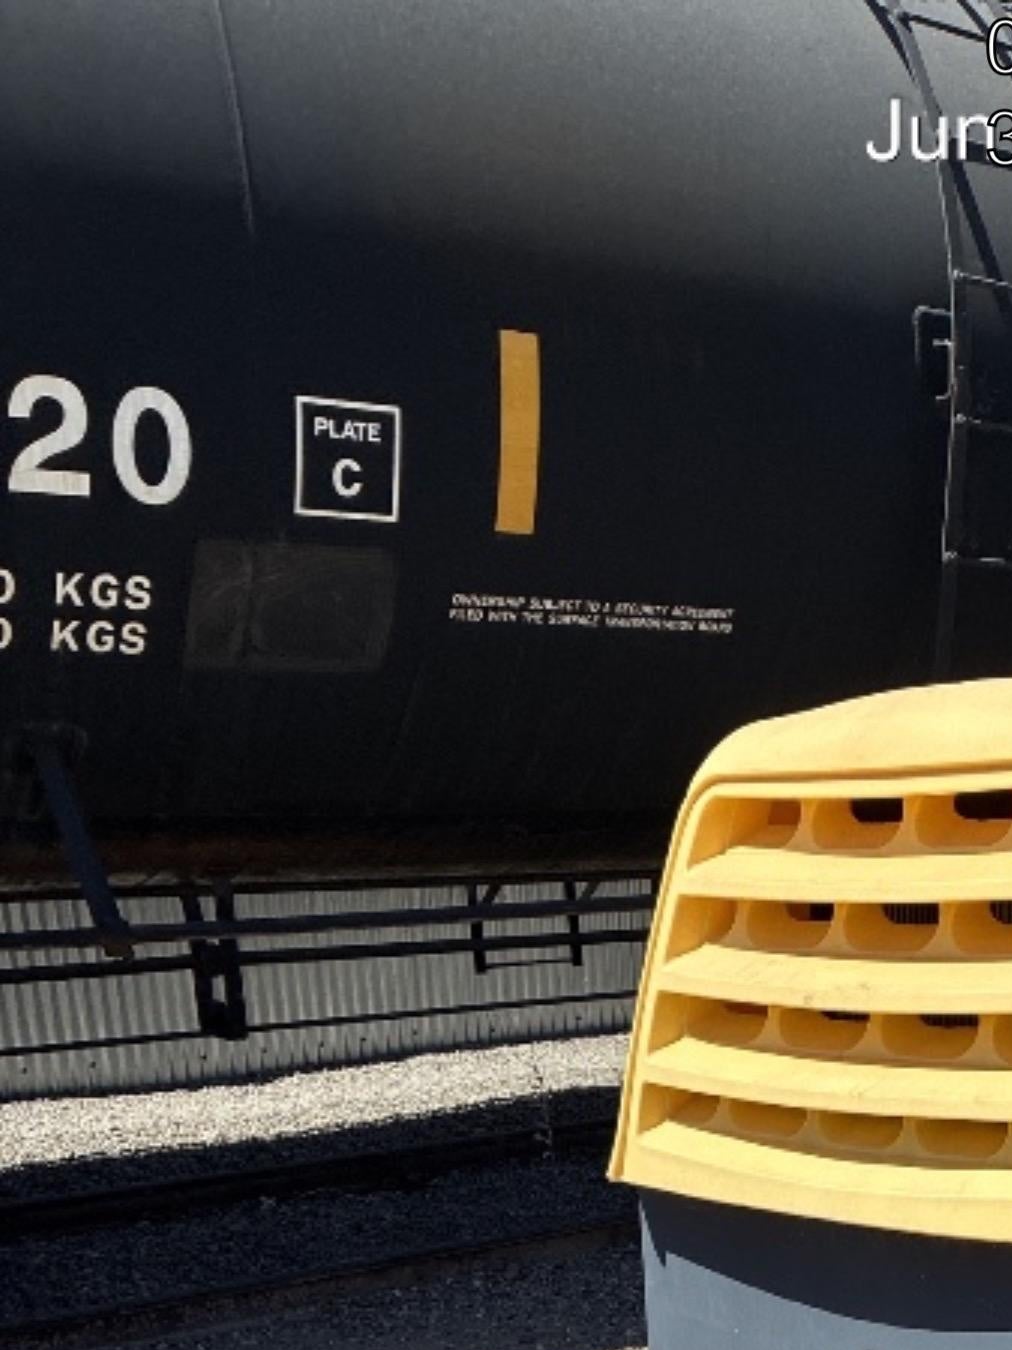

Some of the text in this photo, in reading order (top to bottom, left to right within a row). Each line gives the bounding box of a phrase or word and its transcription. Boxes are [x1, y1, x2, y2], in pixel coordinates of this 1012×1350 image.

[8, 374, 192, 505] 20
[313, 416, 382, 443] PLATE
[331, 458, 363, 497] C
[55, 572, 152, 610] KGS
[50, 620, 147, 655] KGS
